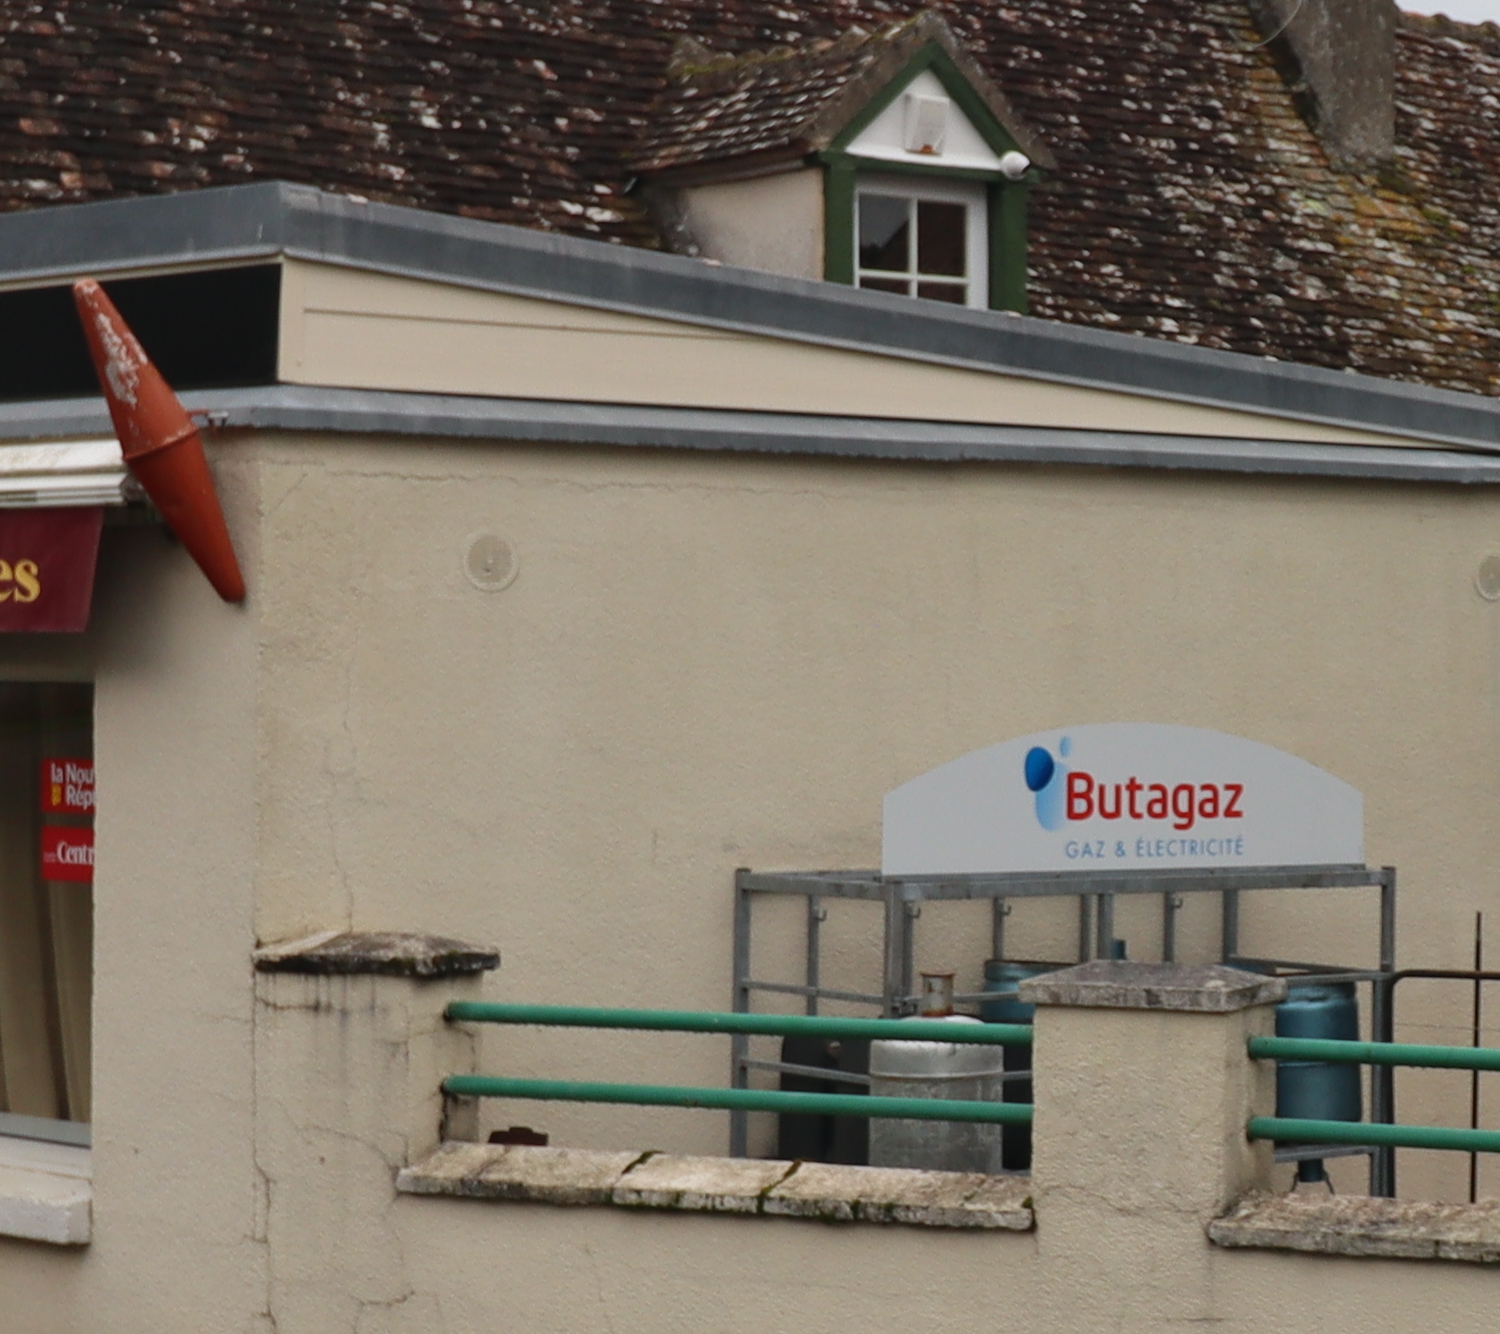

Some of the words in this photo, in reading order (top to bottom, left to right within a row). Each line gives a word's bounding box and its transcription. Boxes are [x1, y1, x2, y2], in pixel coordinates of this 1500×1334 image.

[51, 763, 64, 784] la
[1066, 771, 1244, 830] Butagaz
[1065, 840, 1106, 859] GAZ
[1114, 840, 1127, 858] &
[1136, 834, 1245, 857] ÉLECTRICITÉ
